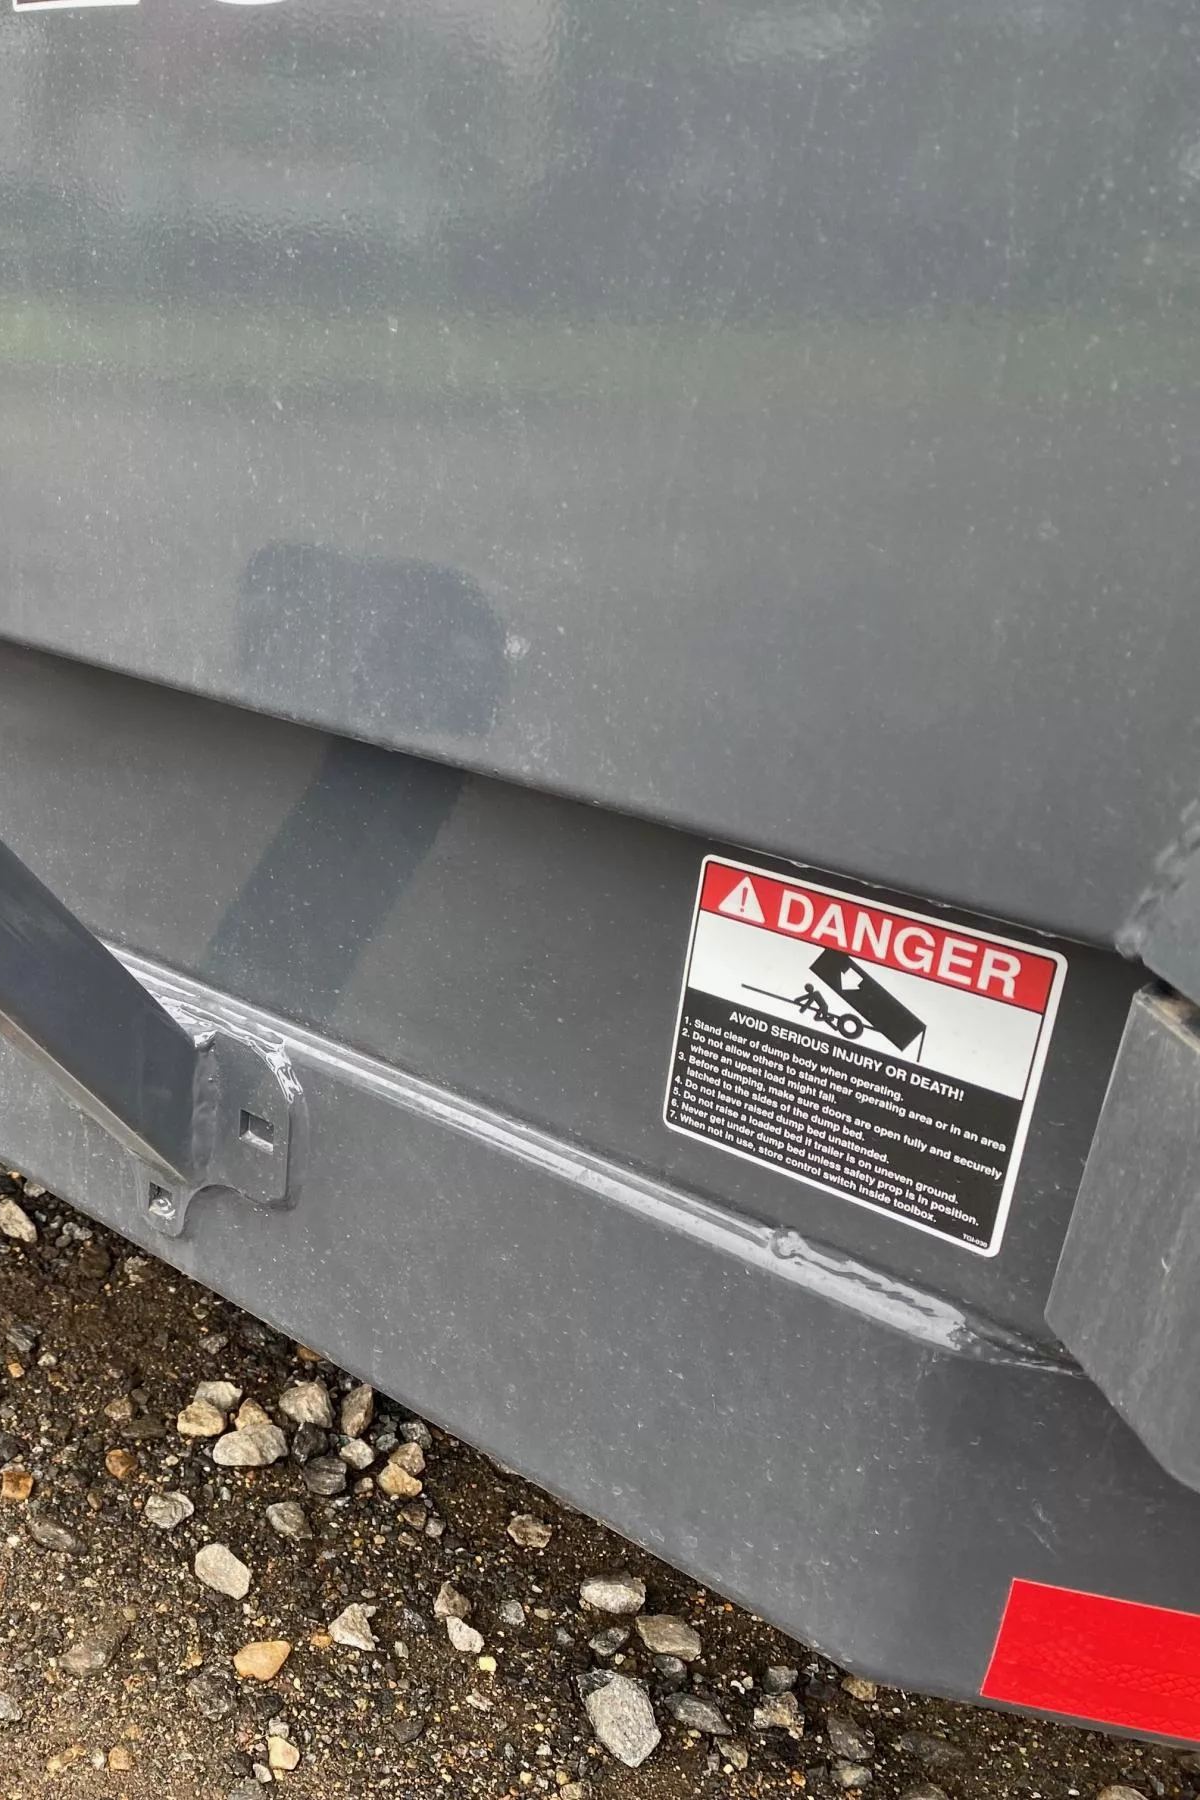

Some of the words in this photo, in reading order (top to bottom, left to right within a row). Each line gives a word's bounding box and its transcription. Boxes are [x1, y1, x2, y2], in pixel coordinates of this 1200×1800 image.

[777, 889, 1021, 998] DANGER
[681, 1027, 690, 1037] 2.
[692, 1030, 706, 1043] Do
[707, 1038, 723, 1050] not
[724, 1044, 751, 1059] allow
[752, 1054, 784, 1071] others
[786, 1065, 796, 1076] to
[798, 1070, 827, 1087] stand
[829, 1081, 853, 1096] near
[854, 1091, 906, 1117] operating
[908, 1110, 933, 1125] area
[935, 1120, 948, 1130] or
[949, 1123, 961, 1135] in
[963, 1130, 978, 1142] an
[980, 1137, 1006, 1152] area
[684, 1016, 692, 1026] 1.
[694, 1019, 722, 1036] Stand
[723, 1031, 748, 1045] clear
[749, 1040, 760, 1049] of
[761, 1043, 790, 1061] dump
[791, 1053, 818, 1071] body
[820, 1064, 848, 1081] when
[849, 1076, 903, 1102] operating.
[686, 1066, 721, 1086] latched
[722, 1080, 732, 1091] to
[734, 1084, 749, 1097] the
[751, 1092, 778, 1108] sides
[779, 1103, 791, 1113] of
[792, 1106, 809, 1119] the
[810, 1114, 840, 1132] dump
[842, 1124, 864, 1141] bed.
[690, 1044, 719, 1060] where
[720, 1055, 732, 1065] an
[734, 1060, 762, 1076] upset
[763, 1069, 785, 1085] load
[787, 1080, 816, 1096] might
[818, 1089, 837, 1104] fall.
[729, 1011, 768, 1032] AVOID
[770, 1024, 829, 1054] SERIOUS
[832, 1045, 883, 1072] INJURY
[885, 1065, 907, 1081] OR
[909, 1072, 964, 1101] DEATH!
[670, 1109, 677, 1119] 7.
[679, 1112, 705, 1130] When
[707, 1125, 723, 1137] not
[724, 1130, 734, 1141] in
[736, 1137, 756, 1152] use,
[758, 1146, 783, 1161] store
[785, 1157, 821, 1176] control
[822, 1171, 856, 1190] switch
[858, 1183, 891, 1204] inside
[893, 1198, 936, 1222] toolbox.
[671, 1098, 679, 1108] 6.
[681, 1101, 708, 1118] Never
[709, 1114, 725, 1126] get
[726, 1120, 755, 1137] under
[756, 1132, 785, 1149] dump
[786, 1142, 806, 1157] bed
[807, 1152, 841, 1171] unless
[843, 1166, 876, 1186] safety
[876, 1180, 903, 1196] prop
[905, 1189, 915, 1200] is
[917, 1193, 928, 1205] in
[929, 1200, 979, 1226] position.
[672, 1086, 681, 1096] 5.
[683, 1090, 696, 1102] Do
[697, 1097, 714, 1109] not
[715, 1104, 739, 1118] raise
[740, 1114, 747, 1122] a
[748, 1115, 782, 1135] loaded
[783, 1128, 803, 1143] bed
[804, 1136, 812, 1146] if
[813, 1140, 844, 1159] trailer
[845, 1152, 855, 1164] is
[857, 1159, 872, 1170] on
[874, 1165, 913, 1186] uneven
[915, 1182, 958, 1204] ground.
[674, 1075, 683, 1085] 4.
[684, 1078, 698, 1090] Do
[699, 1085, 715, 1097] not
[717, 1090, 742, 1107] leave
[743, 1102, 774, 1119] raised
[775, 1114, 805, 1132] dump
[806, 1124, 826, 1139] bed
[827, 1134, 889, 1164] unattended.
[678, 1051, 686, 1061] 3.
[688, 1054, 719, 1073] Before
[721, 1068, 766, 1092] dumping,
[768, 1086, 795, 1101] make
[796, 1096, 820, 1111] sure
[821, 1105, 852, 1123] doors
[853, 1118, 871, 1130] are
[873, 1125, 901, 1141] open
[903, 1134, 927, 1152] fully
[929, 1146, 951, 1160] and
[953, 1155, 1002, 1180] securely
